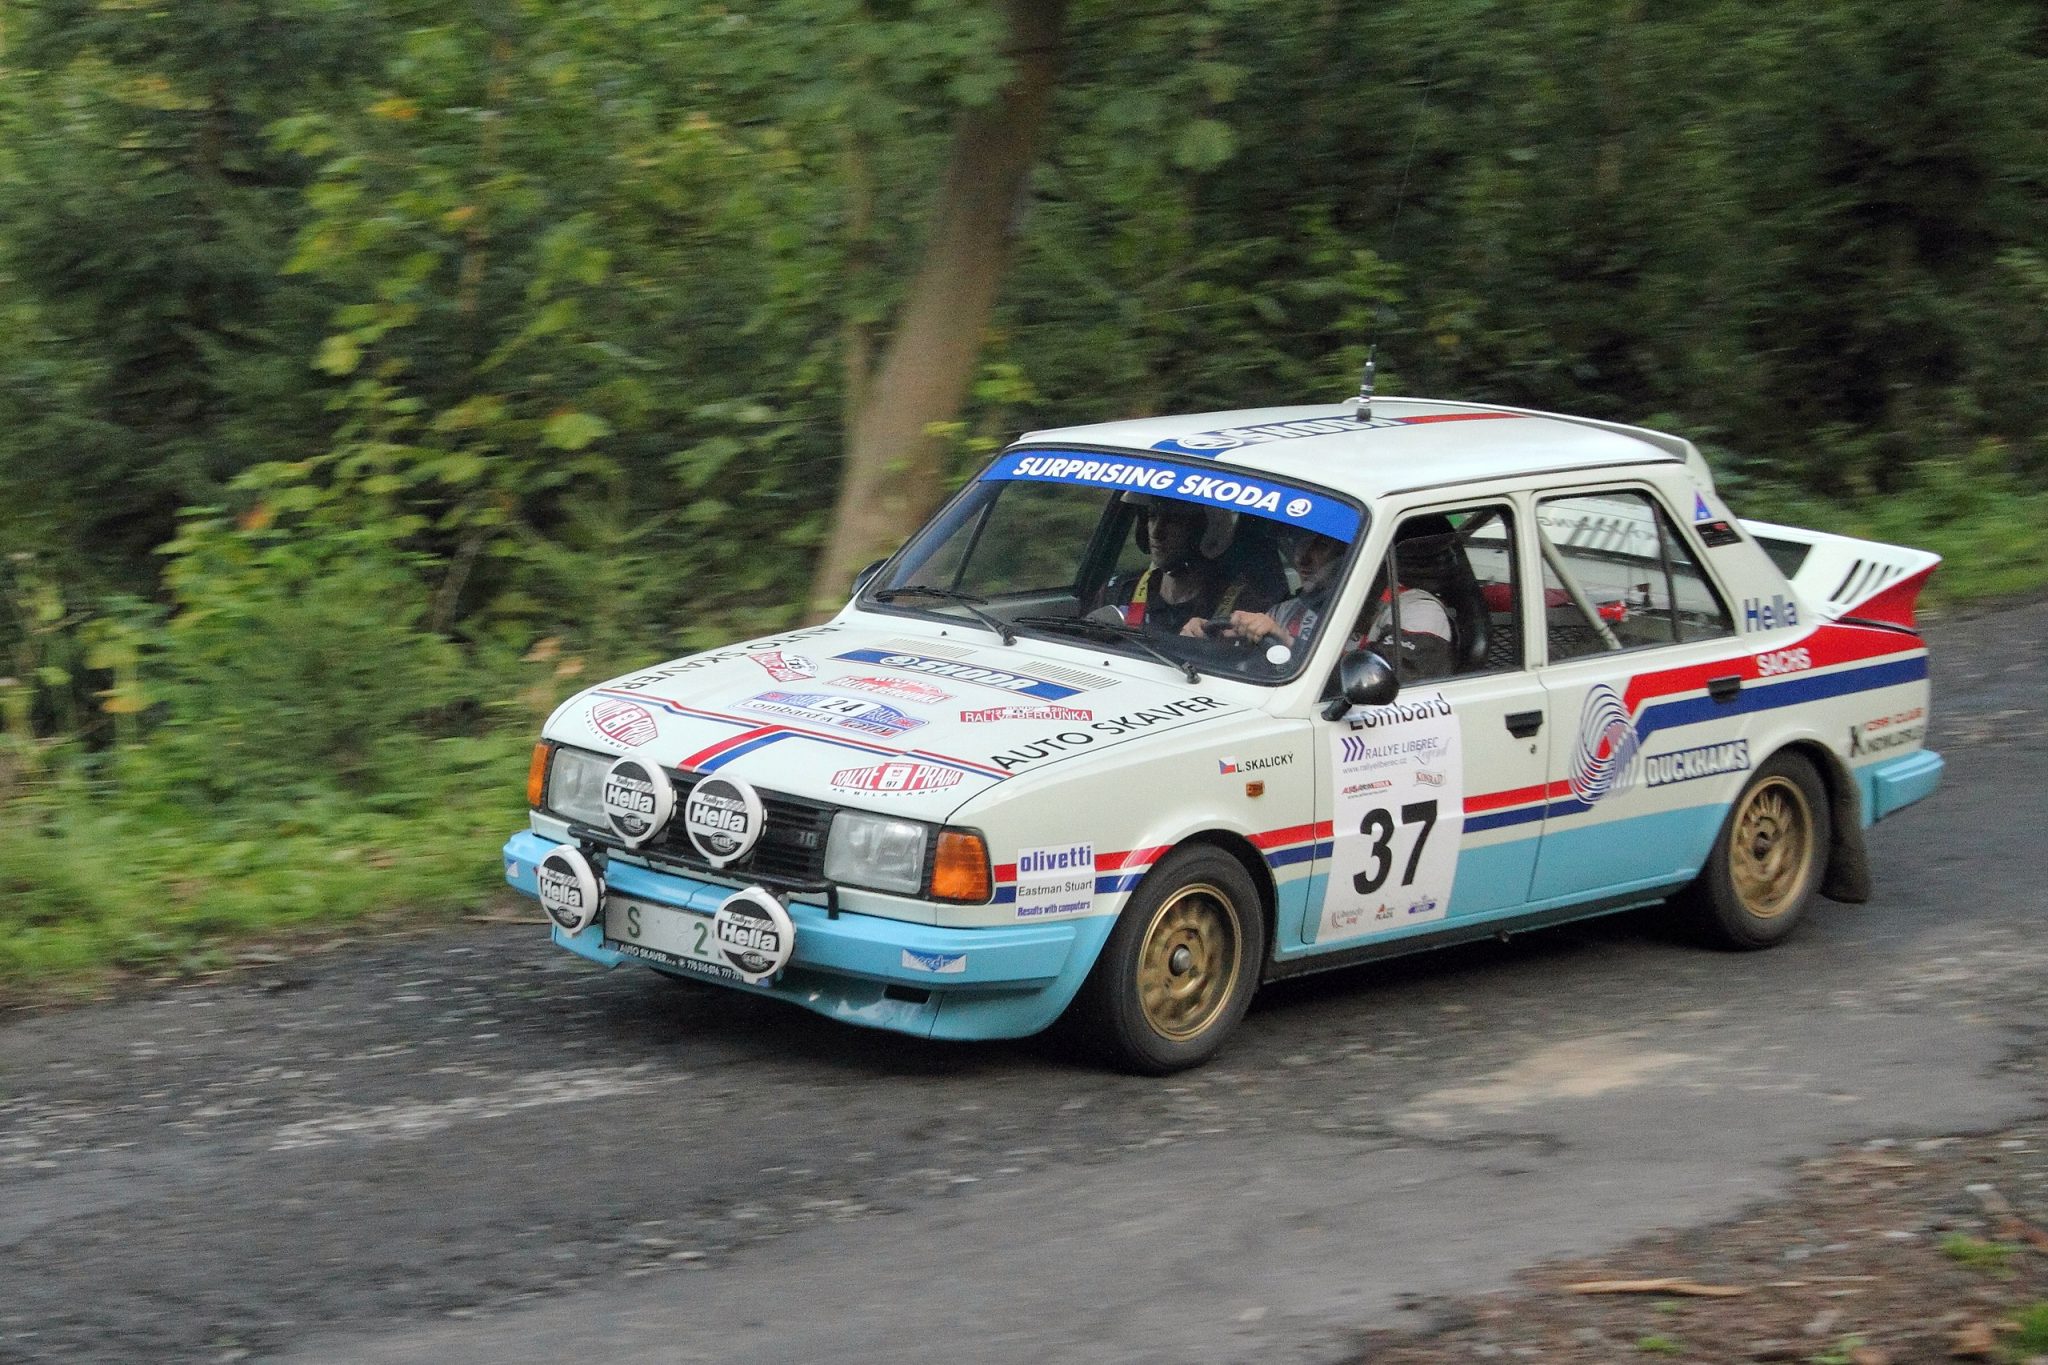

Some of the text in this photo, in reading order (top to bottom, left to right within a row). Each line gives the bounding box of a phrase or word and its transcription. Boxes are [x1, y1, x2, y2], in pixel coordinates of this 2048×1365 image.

[1013, 457, 1281, 512] SURPRISING SKODA
[1745, 594, 1798, 633] Hella
[1757, 648, 1811, 677] SACHS
[819, 699, 866, 715] 24
[1019, 709, 1090, 721] BEROUNKA
[990, 696, 1230, 770] AUTO SKAVER
[1365, 743, 1402, 760] RALLYE
[1402, 736, 1440, 754] LIBEREC
[907, 765, 961, 790] PRAHA
[1648, 743, 1749, 785] DUCKHAMS
[607, 784, 654, 813] Hella
[691, 803, 746, 832] Hella
[1020, 845, 1091, 872] olivetti
[1353, 799, 1438, 895] 37
[541, 878, 581, 906] Hella
[1018, 880, 1093, 897] Eastman Stuart
[627, 906, 642, 938] S
[1017, 901, 1091, 917] Results with computers
[720, 922, 777, 951] Hella
